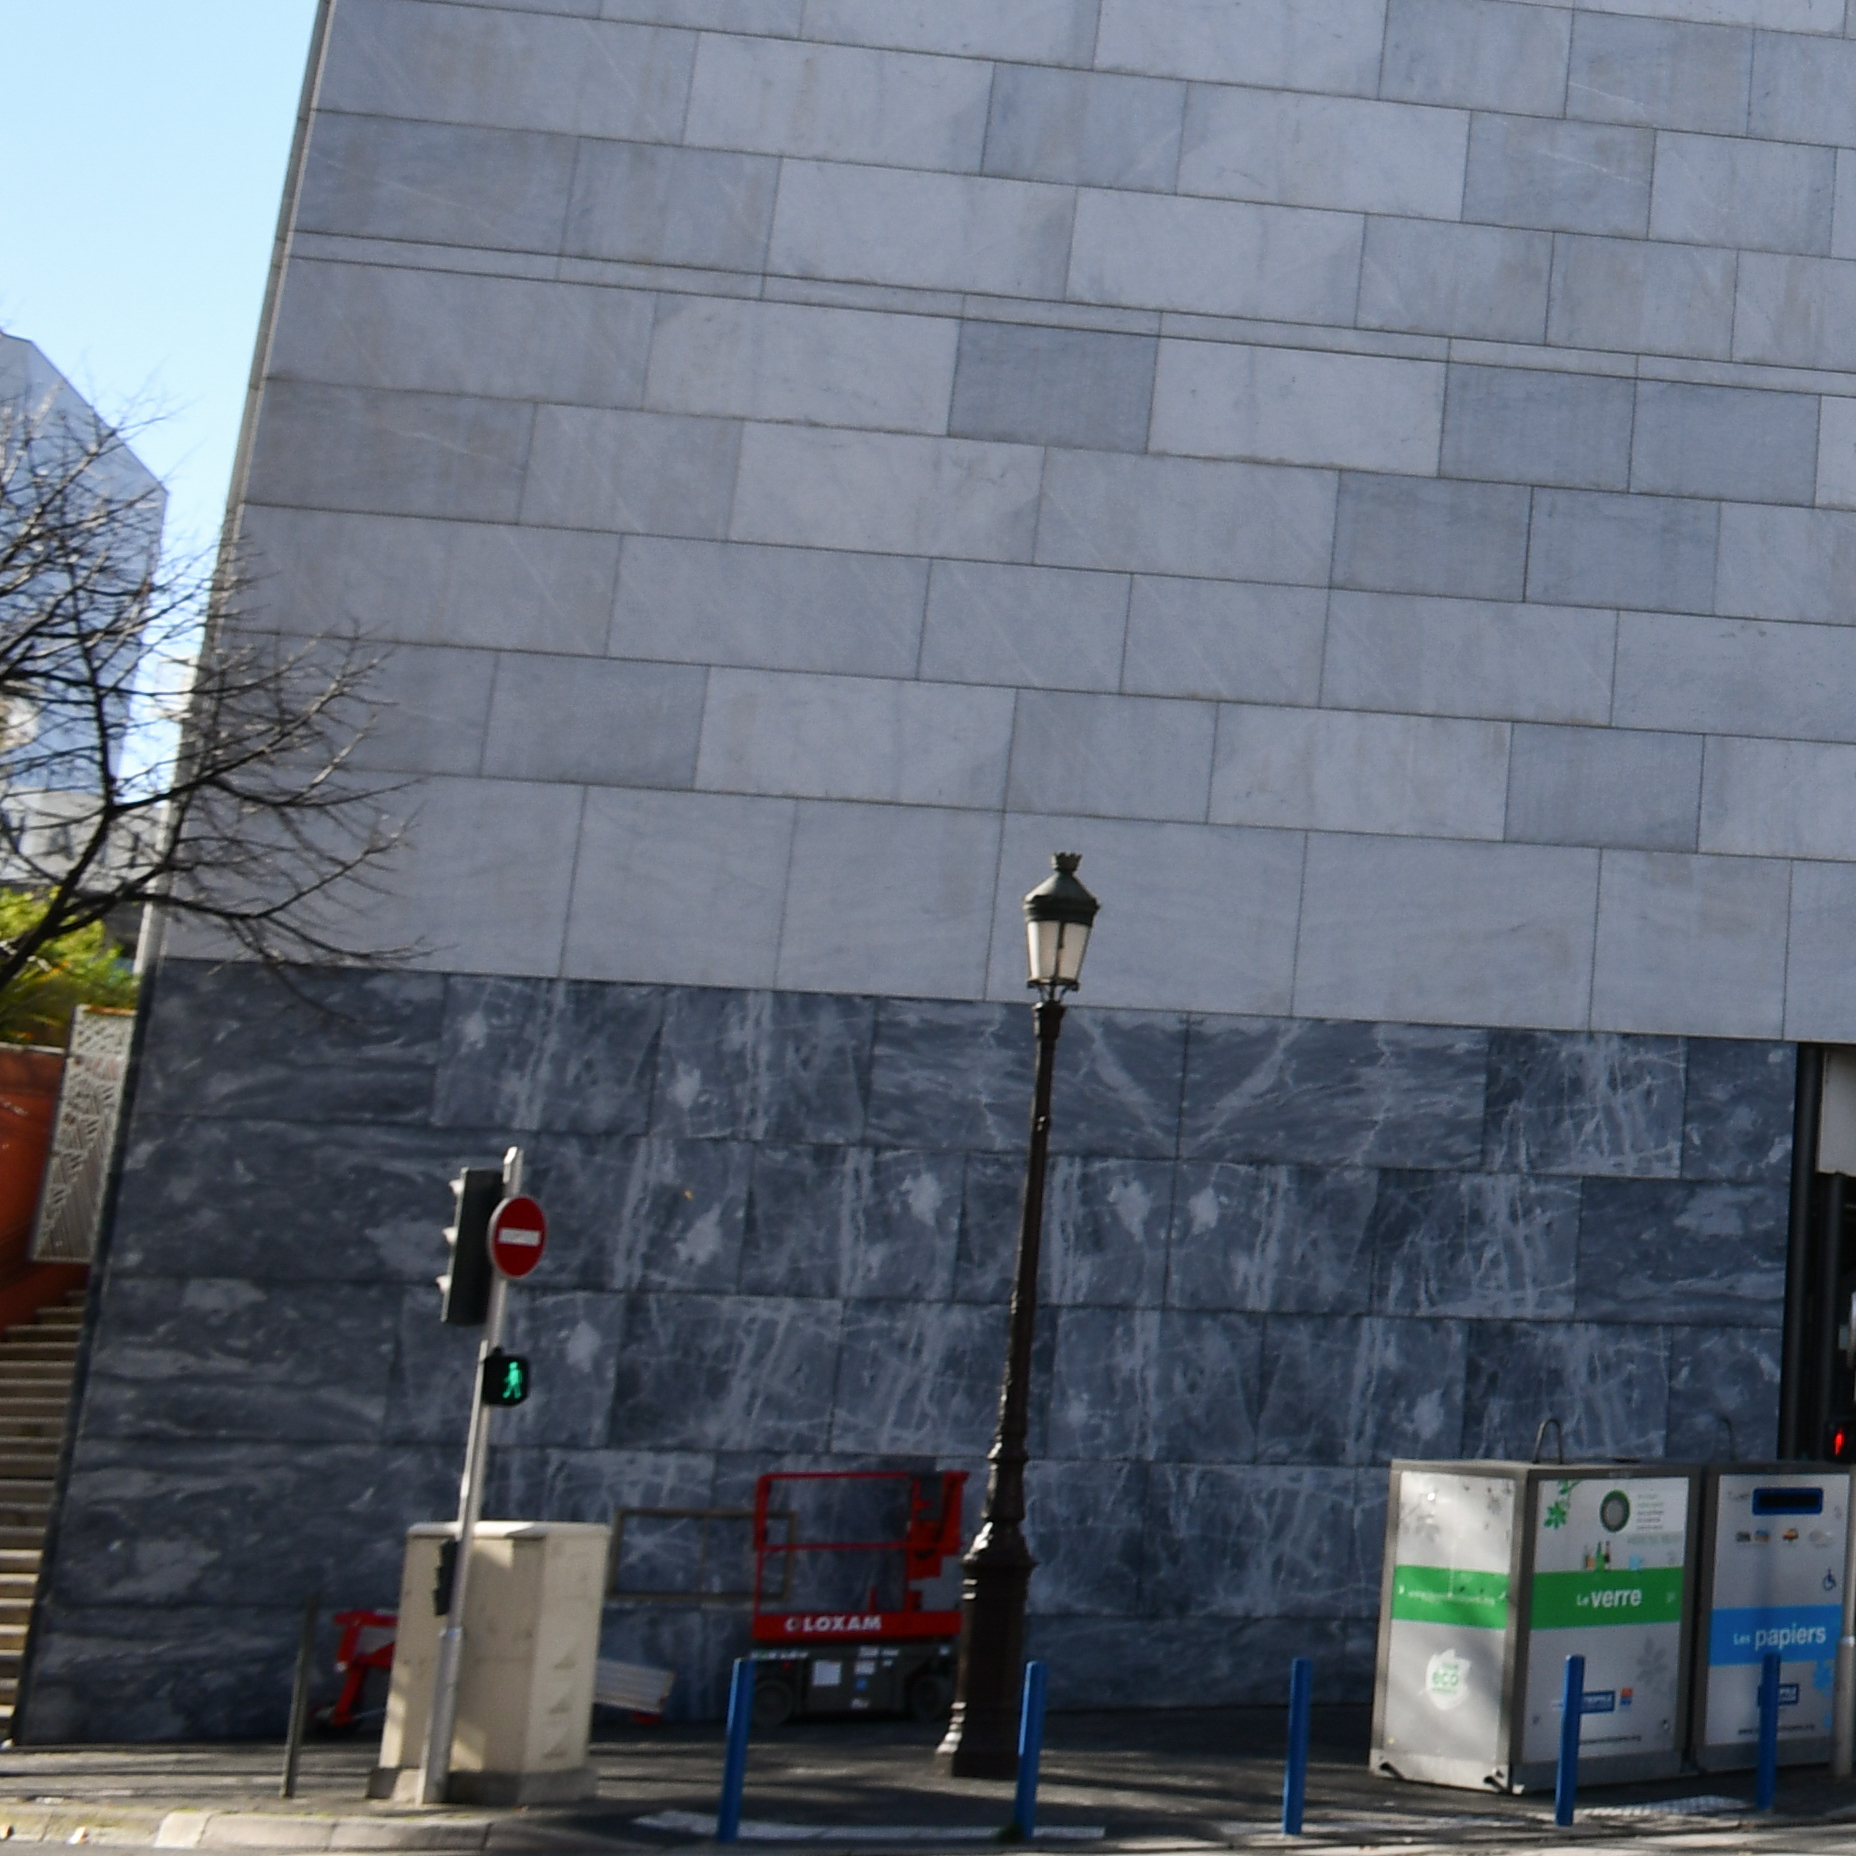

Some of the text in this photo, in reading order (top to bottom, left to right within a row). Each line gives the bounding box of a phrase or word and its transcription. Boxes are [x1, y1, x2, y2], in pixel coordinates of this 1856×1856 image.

[1591, 1588, 1642, 1608] verre
[802, 1615, 882, 1632] LOXAM
[1733, 1622, 1827, 1652] Les papiers
